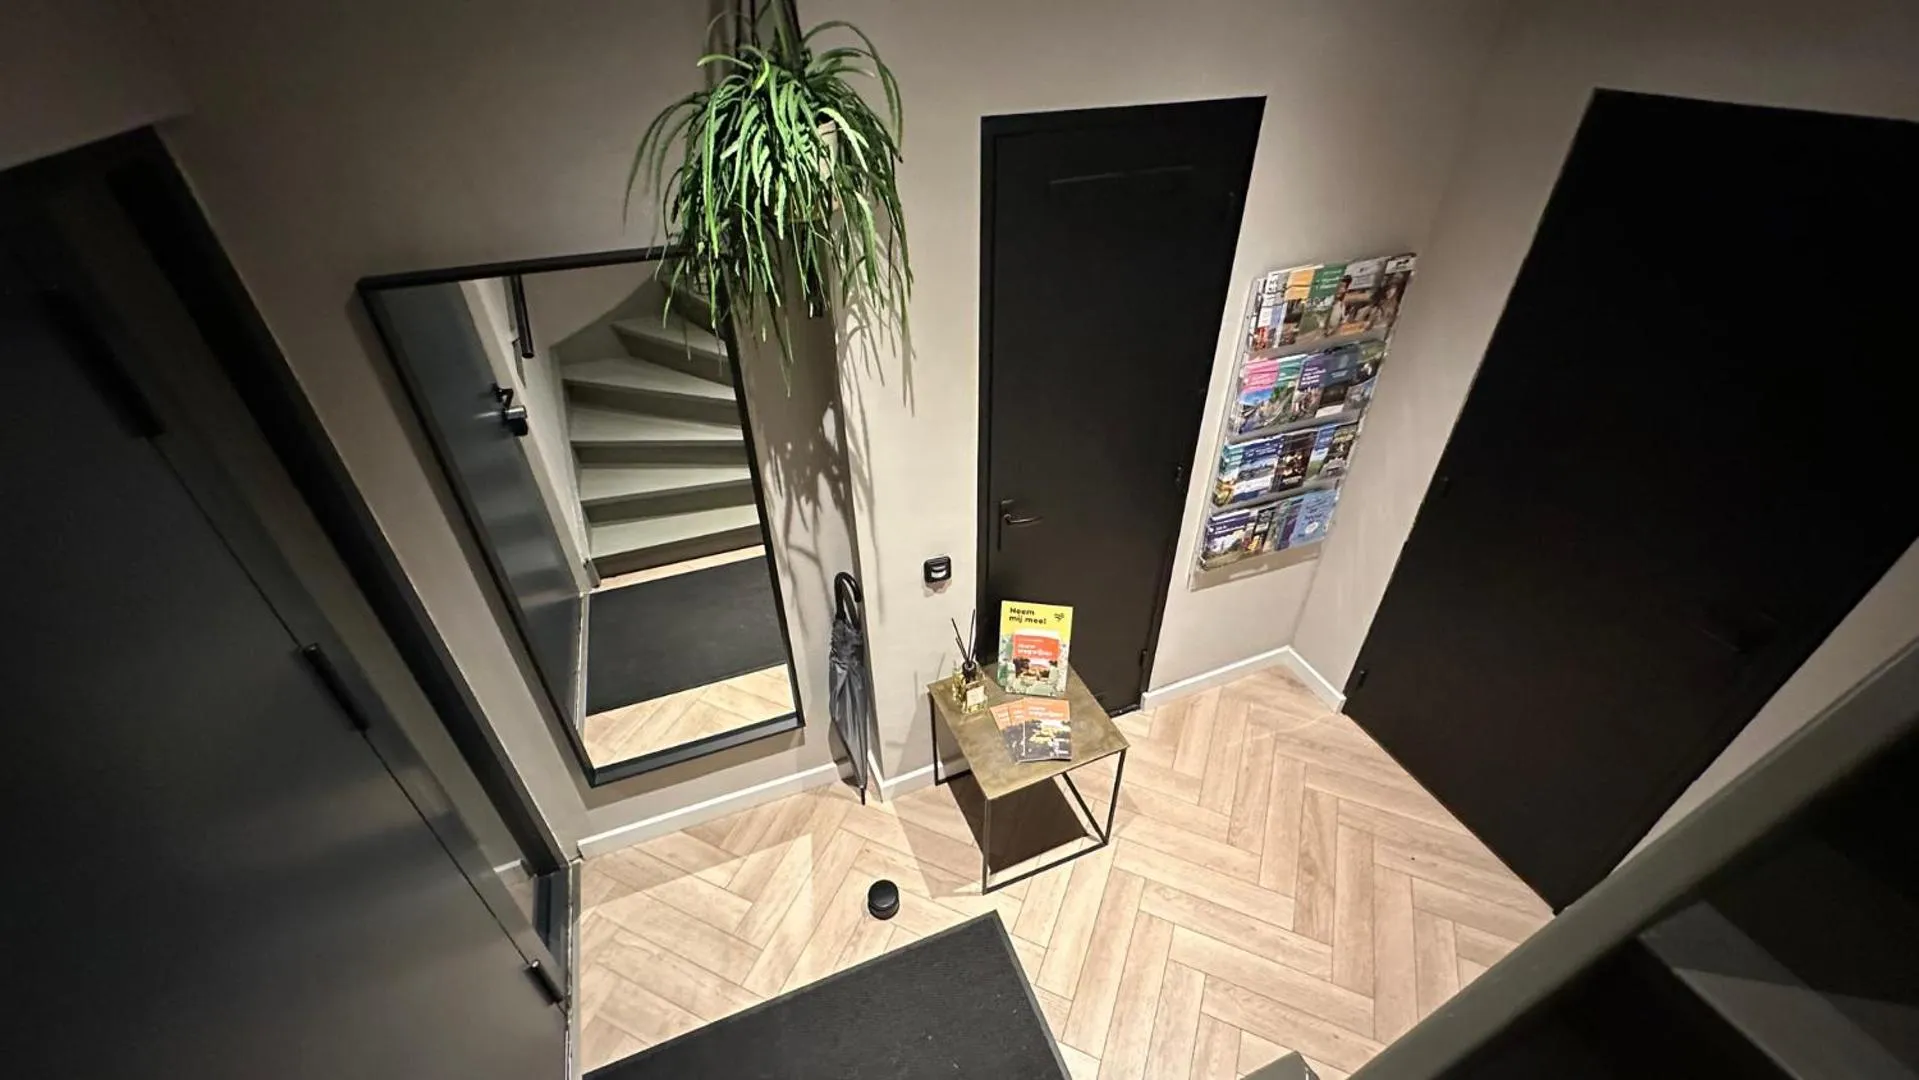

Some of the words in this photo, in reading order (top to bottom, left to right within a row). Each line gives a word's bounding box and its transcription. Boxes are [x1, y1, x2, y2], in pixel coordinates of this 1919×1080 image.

[1010, 607, 1035, 616] Neem
[1009, 615, 1023, 624] mij
[1024, 617, 1047, 625] mee!
